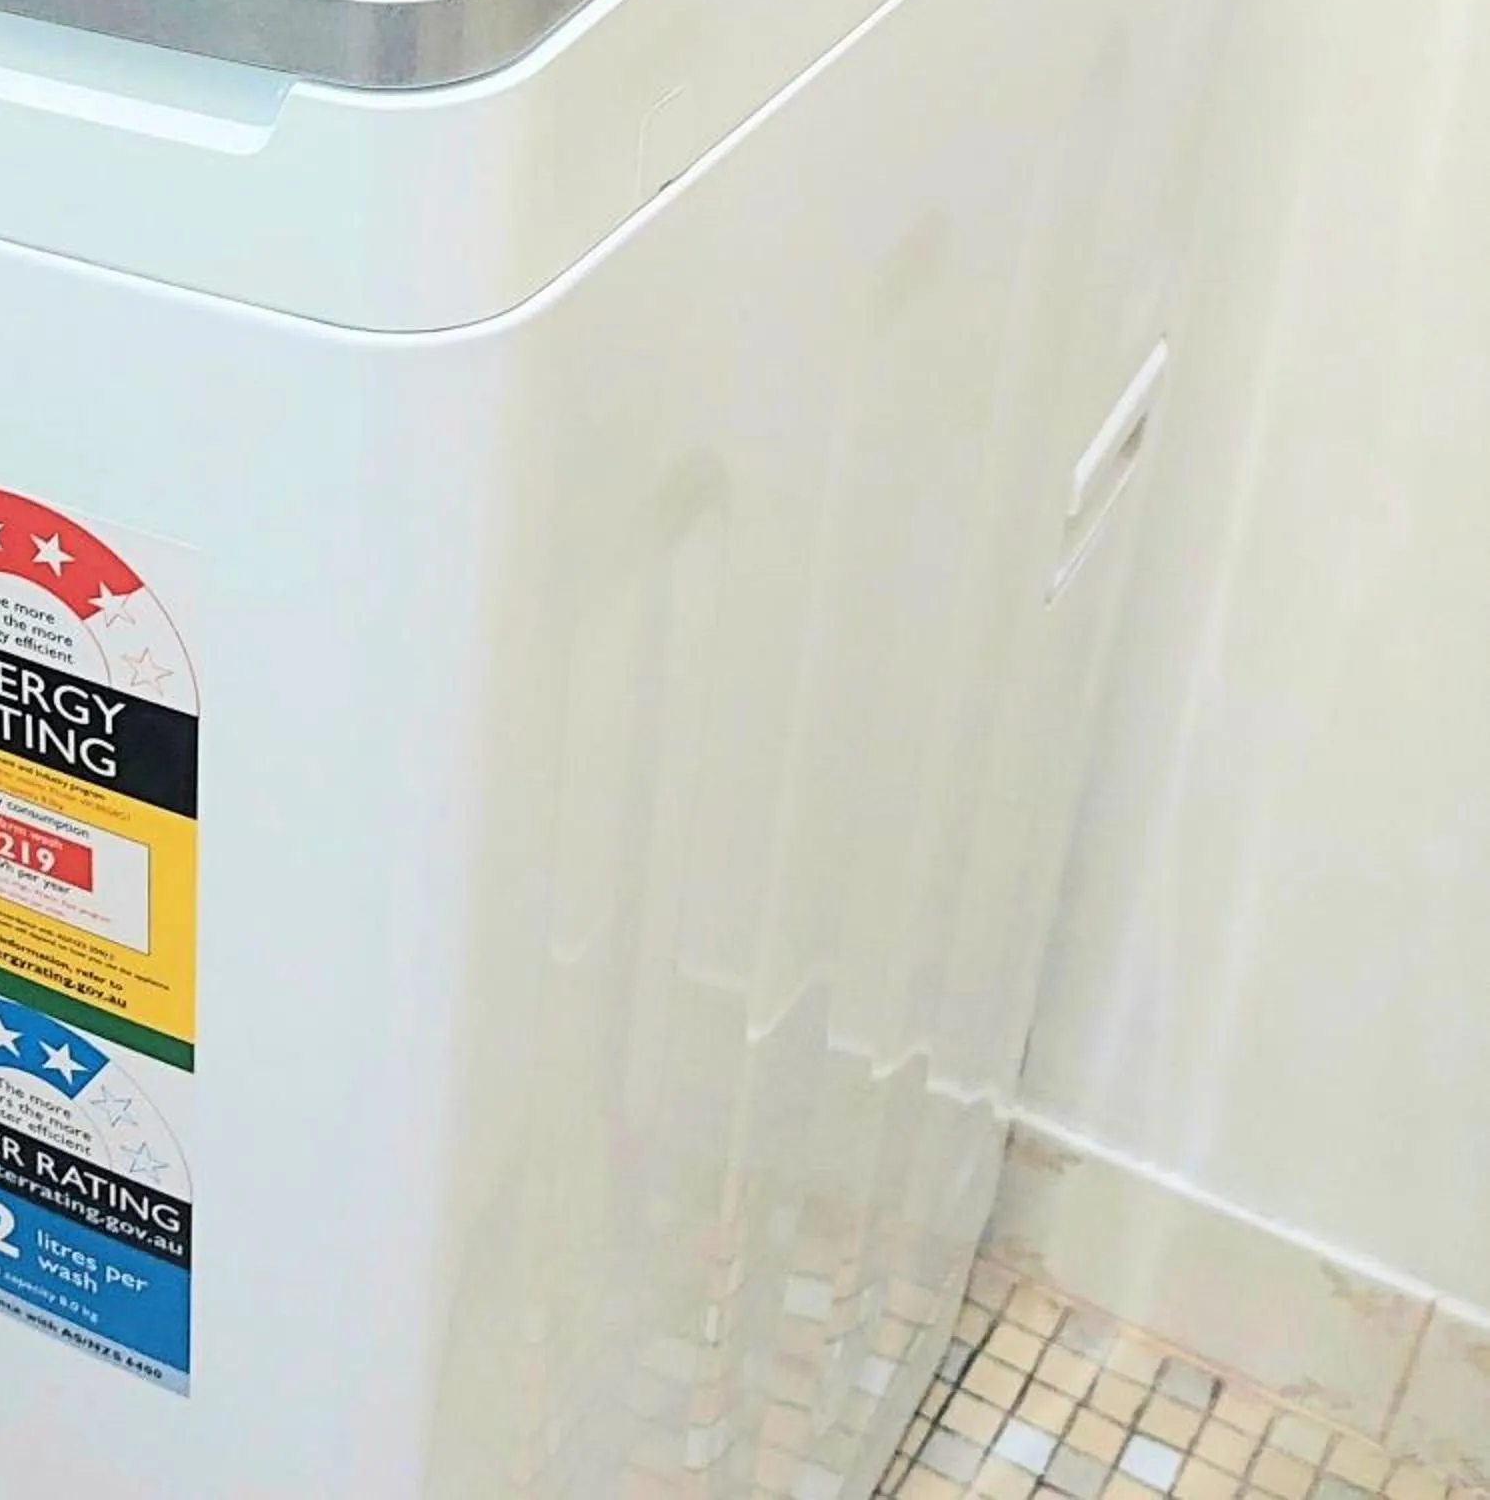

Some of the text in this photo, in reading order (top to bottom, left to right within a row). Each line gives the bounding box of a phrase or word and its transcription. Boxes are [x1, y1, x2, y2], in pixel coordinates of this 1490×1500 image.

[3, 612, 28, 632] the
[31, 625, 74, 648] more
[13, 602, 56, 625] more
[14, 635, 75, 665] efficient
[7, 801, 90, 838] consumption
[17, 868, 38, 883] per
[43, 878, 71, 894] year
[76, 967, 107, 984] refer
[109, 979, 124, 992] to
[19, 1100, 44, 1121] the
[48, 1116, 93, 1143] more
[29, 1091, 72, 1118] more
[27, 1119, 93, 1157] efficient
[36, 1150, 181, 1234] RATING
[36, 1229, 98, 1273] litres
[104, 1264, 150, 1293] per
[37, 1254, 99, 1295] wash
[25, 1311, 58, 1334] with
